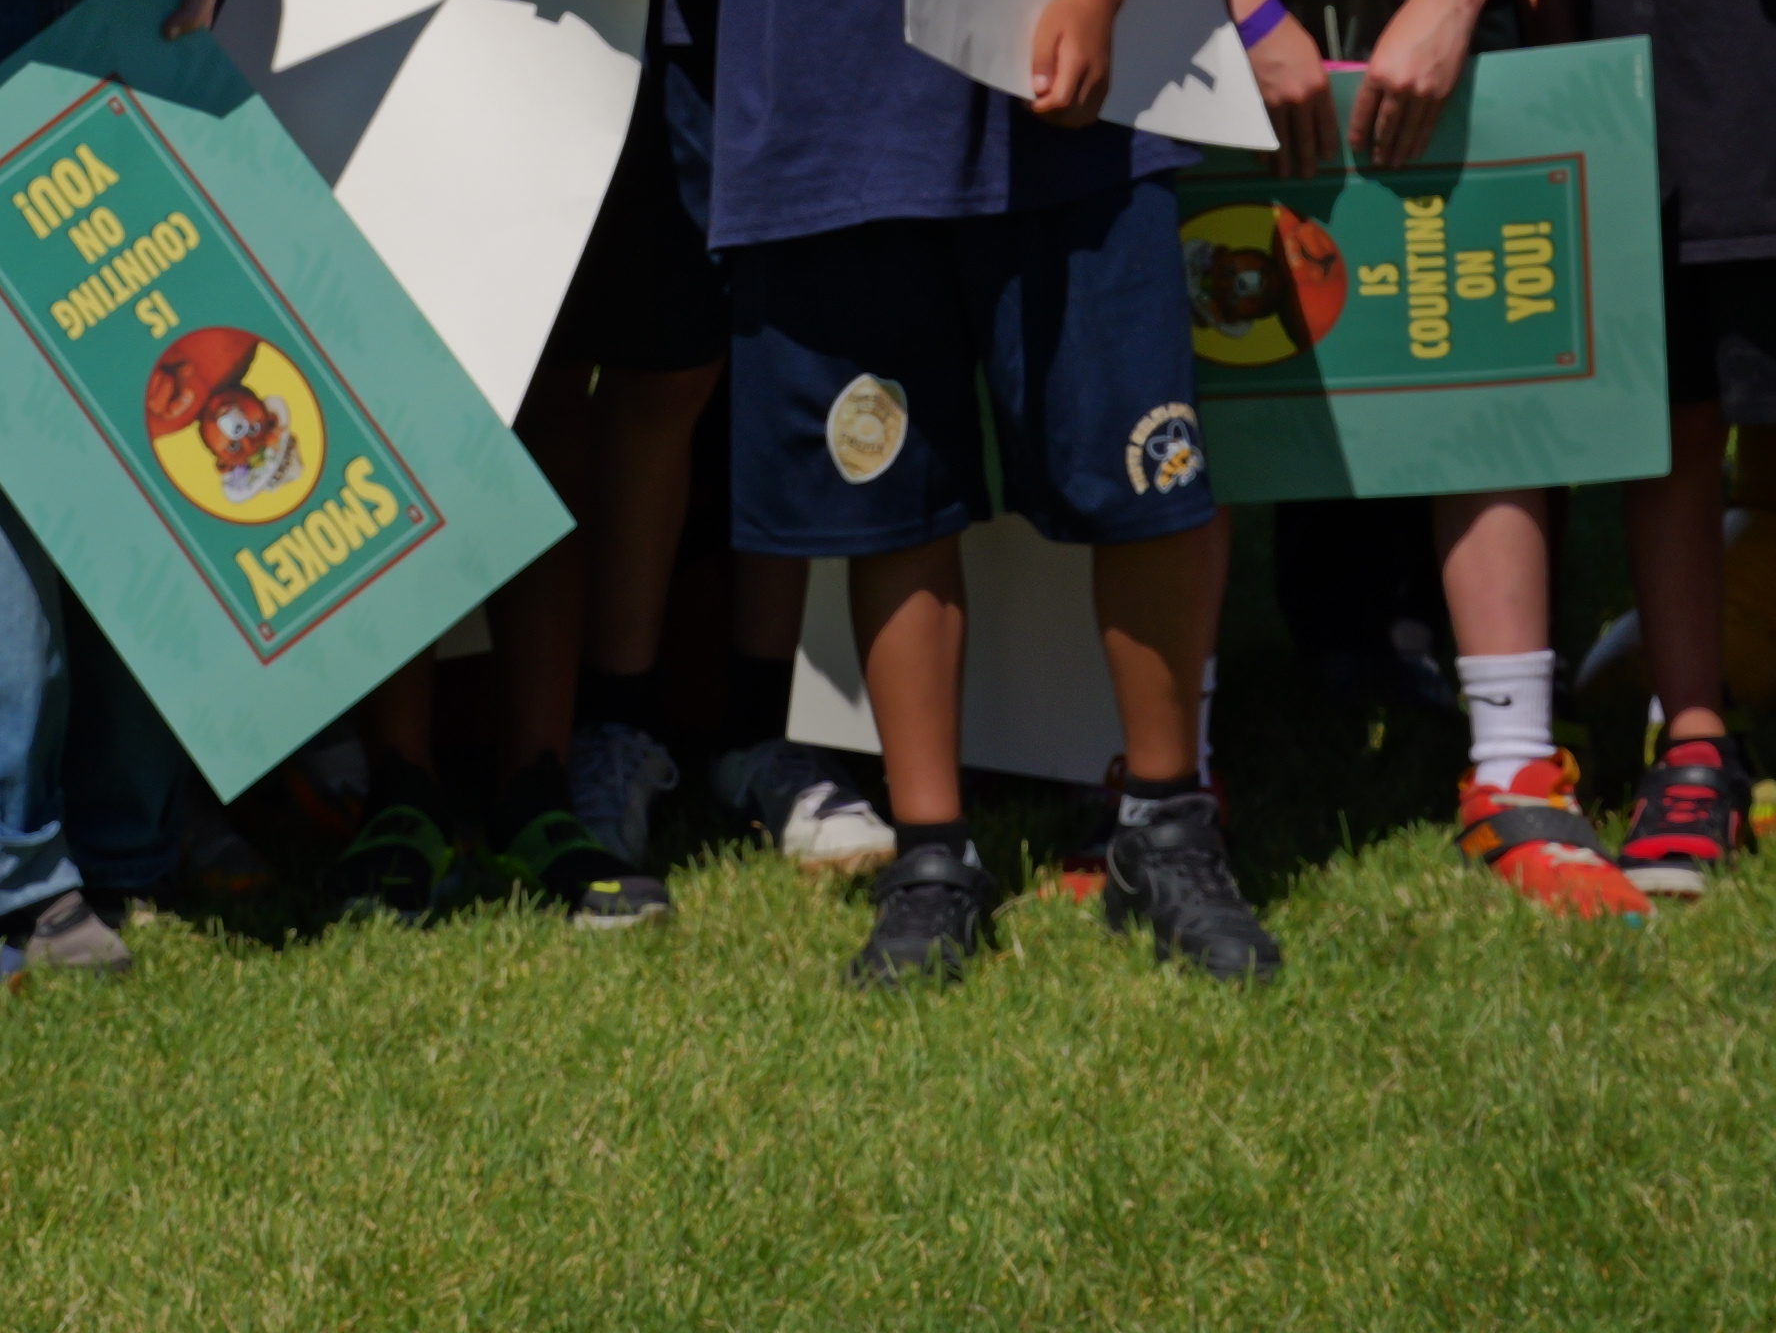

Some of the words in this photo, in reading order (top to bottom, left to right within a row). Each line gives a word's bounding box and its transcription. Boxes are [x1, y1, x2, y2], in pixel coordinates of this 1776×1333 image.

[12, 142, 119, 240] YOU!
[70, 206, 124, 264] ON
[50, 210, 202, 341] COUNTING
[135, 290, 181, 339] IS
[1358, 262, 1399, 296] IS
[1403, 194, 1450, 360] COUNTING
[1455, 250, 1497, 300] ON
[1502, 220, 1555, 323] YOU!
[233, 455, 399, 620] SMOKEY
